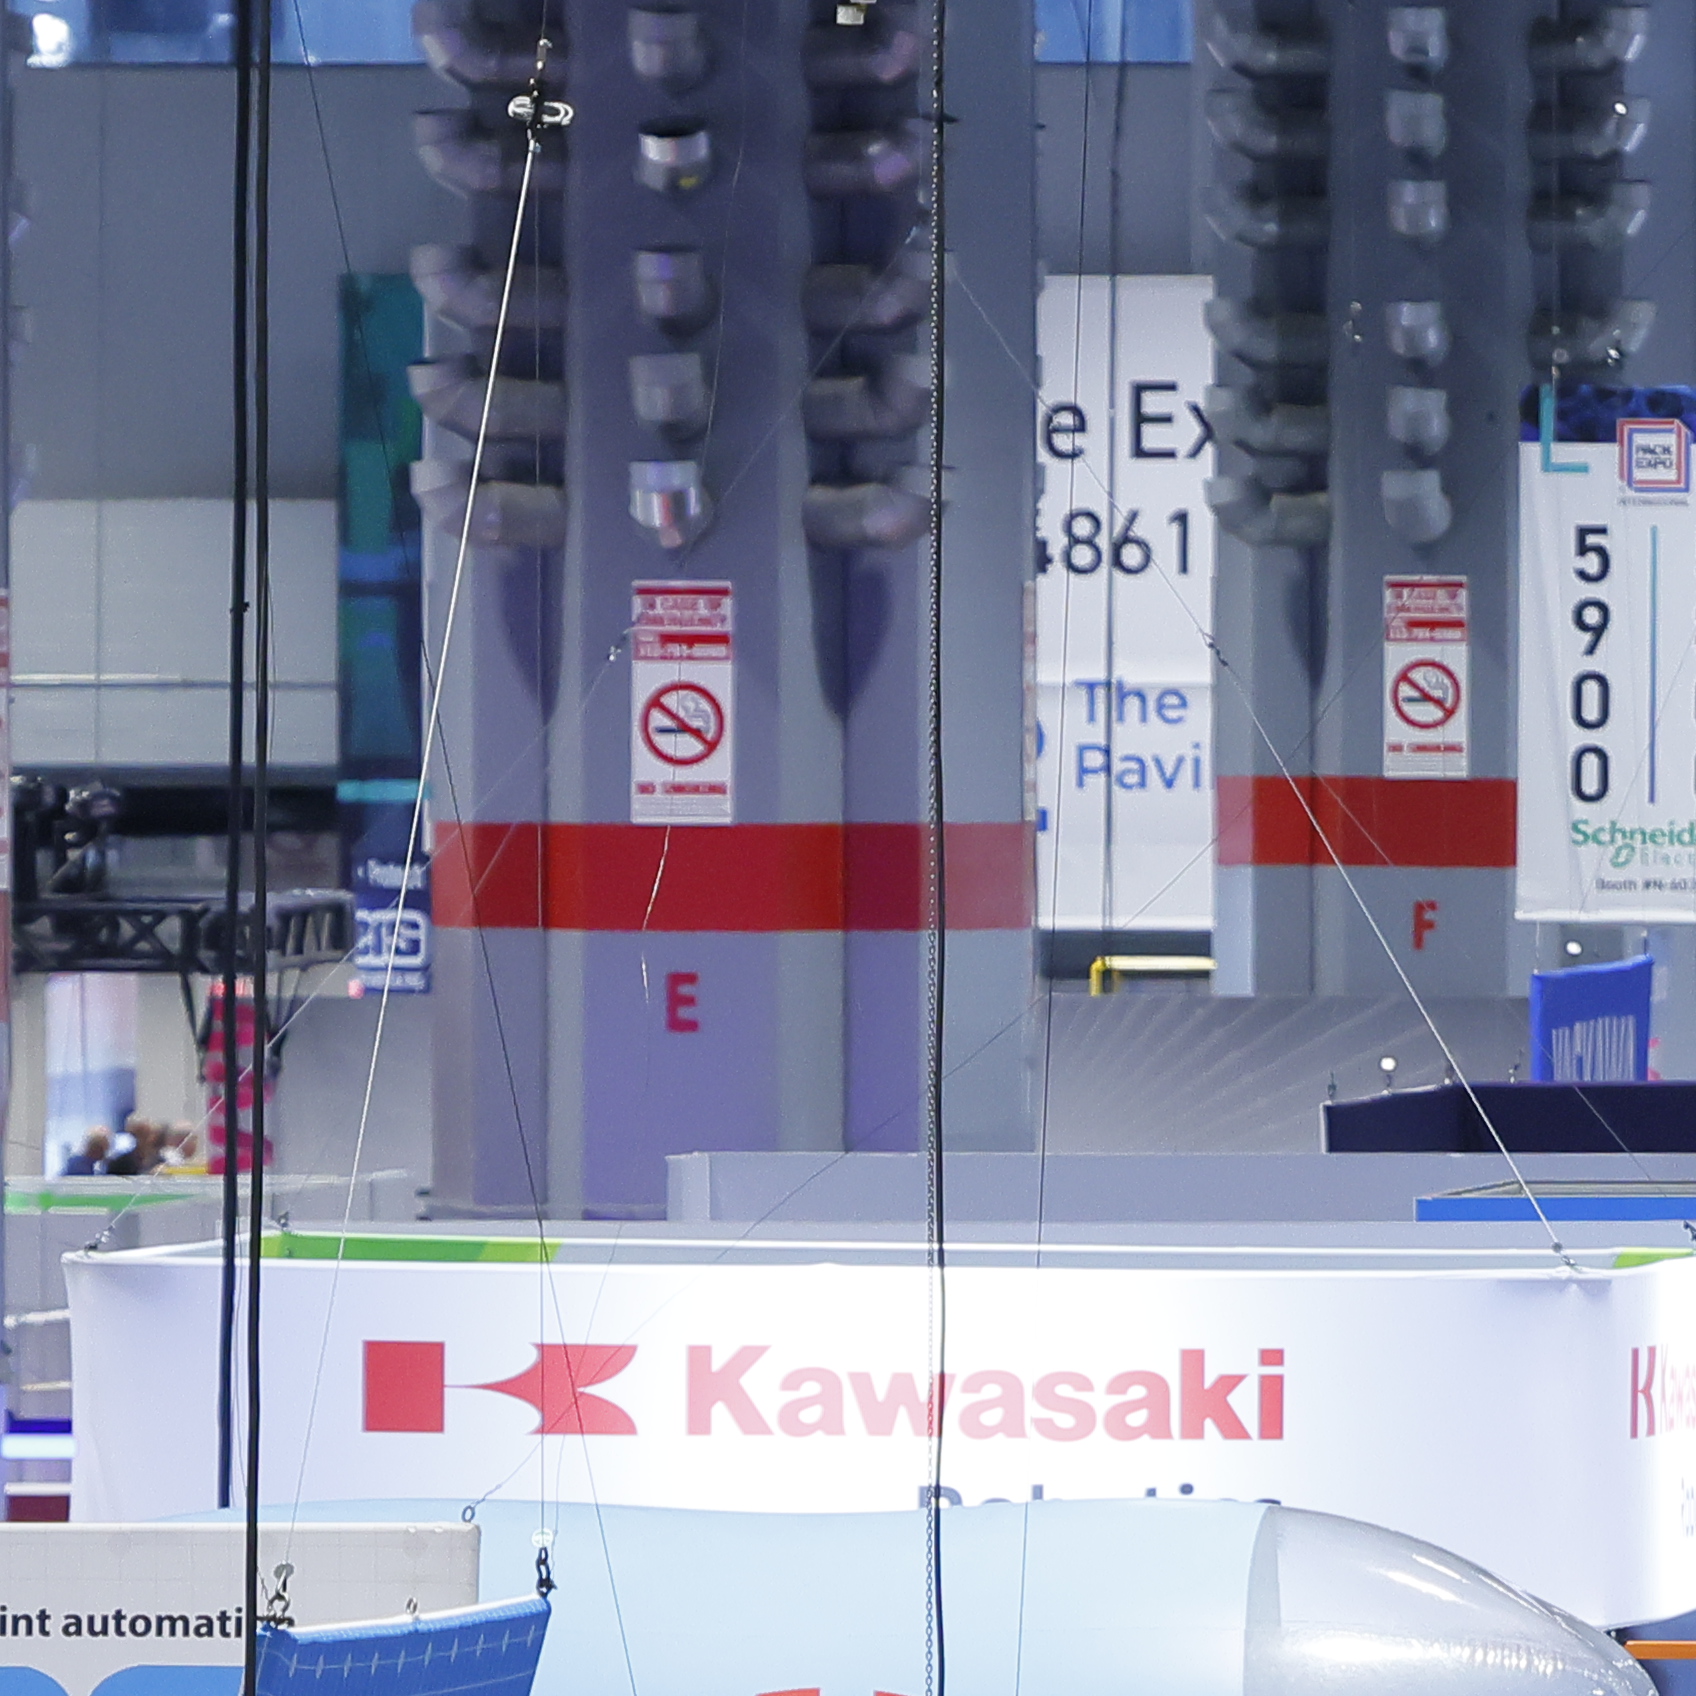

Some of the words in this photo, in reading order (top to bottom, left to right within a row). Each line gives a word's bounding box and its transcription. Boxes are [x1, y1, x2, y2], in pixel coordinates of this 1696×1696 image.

[1074, 679, 1189, 725] The
[1076, 743, 1202, 791] Pavi
[1413, 900, 1438, 951] F
[666, 973, 700, 1033] E
[686, 1344, 1285, 1443] Kawasaki
[62, 1607, 243, 1638] automati
